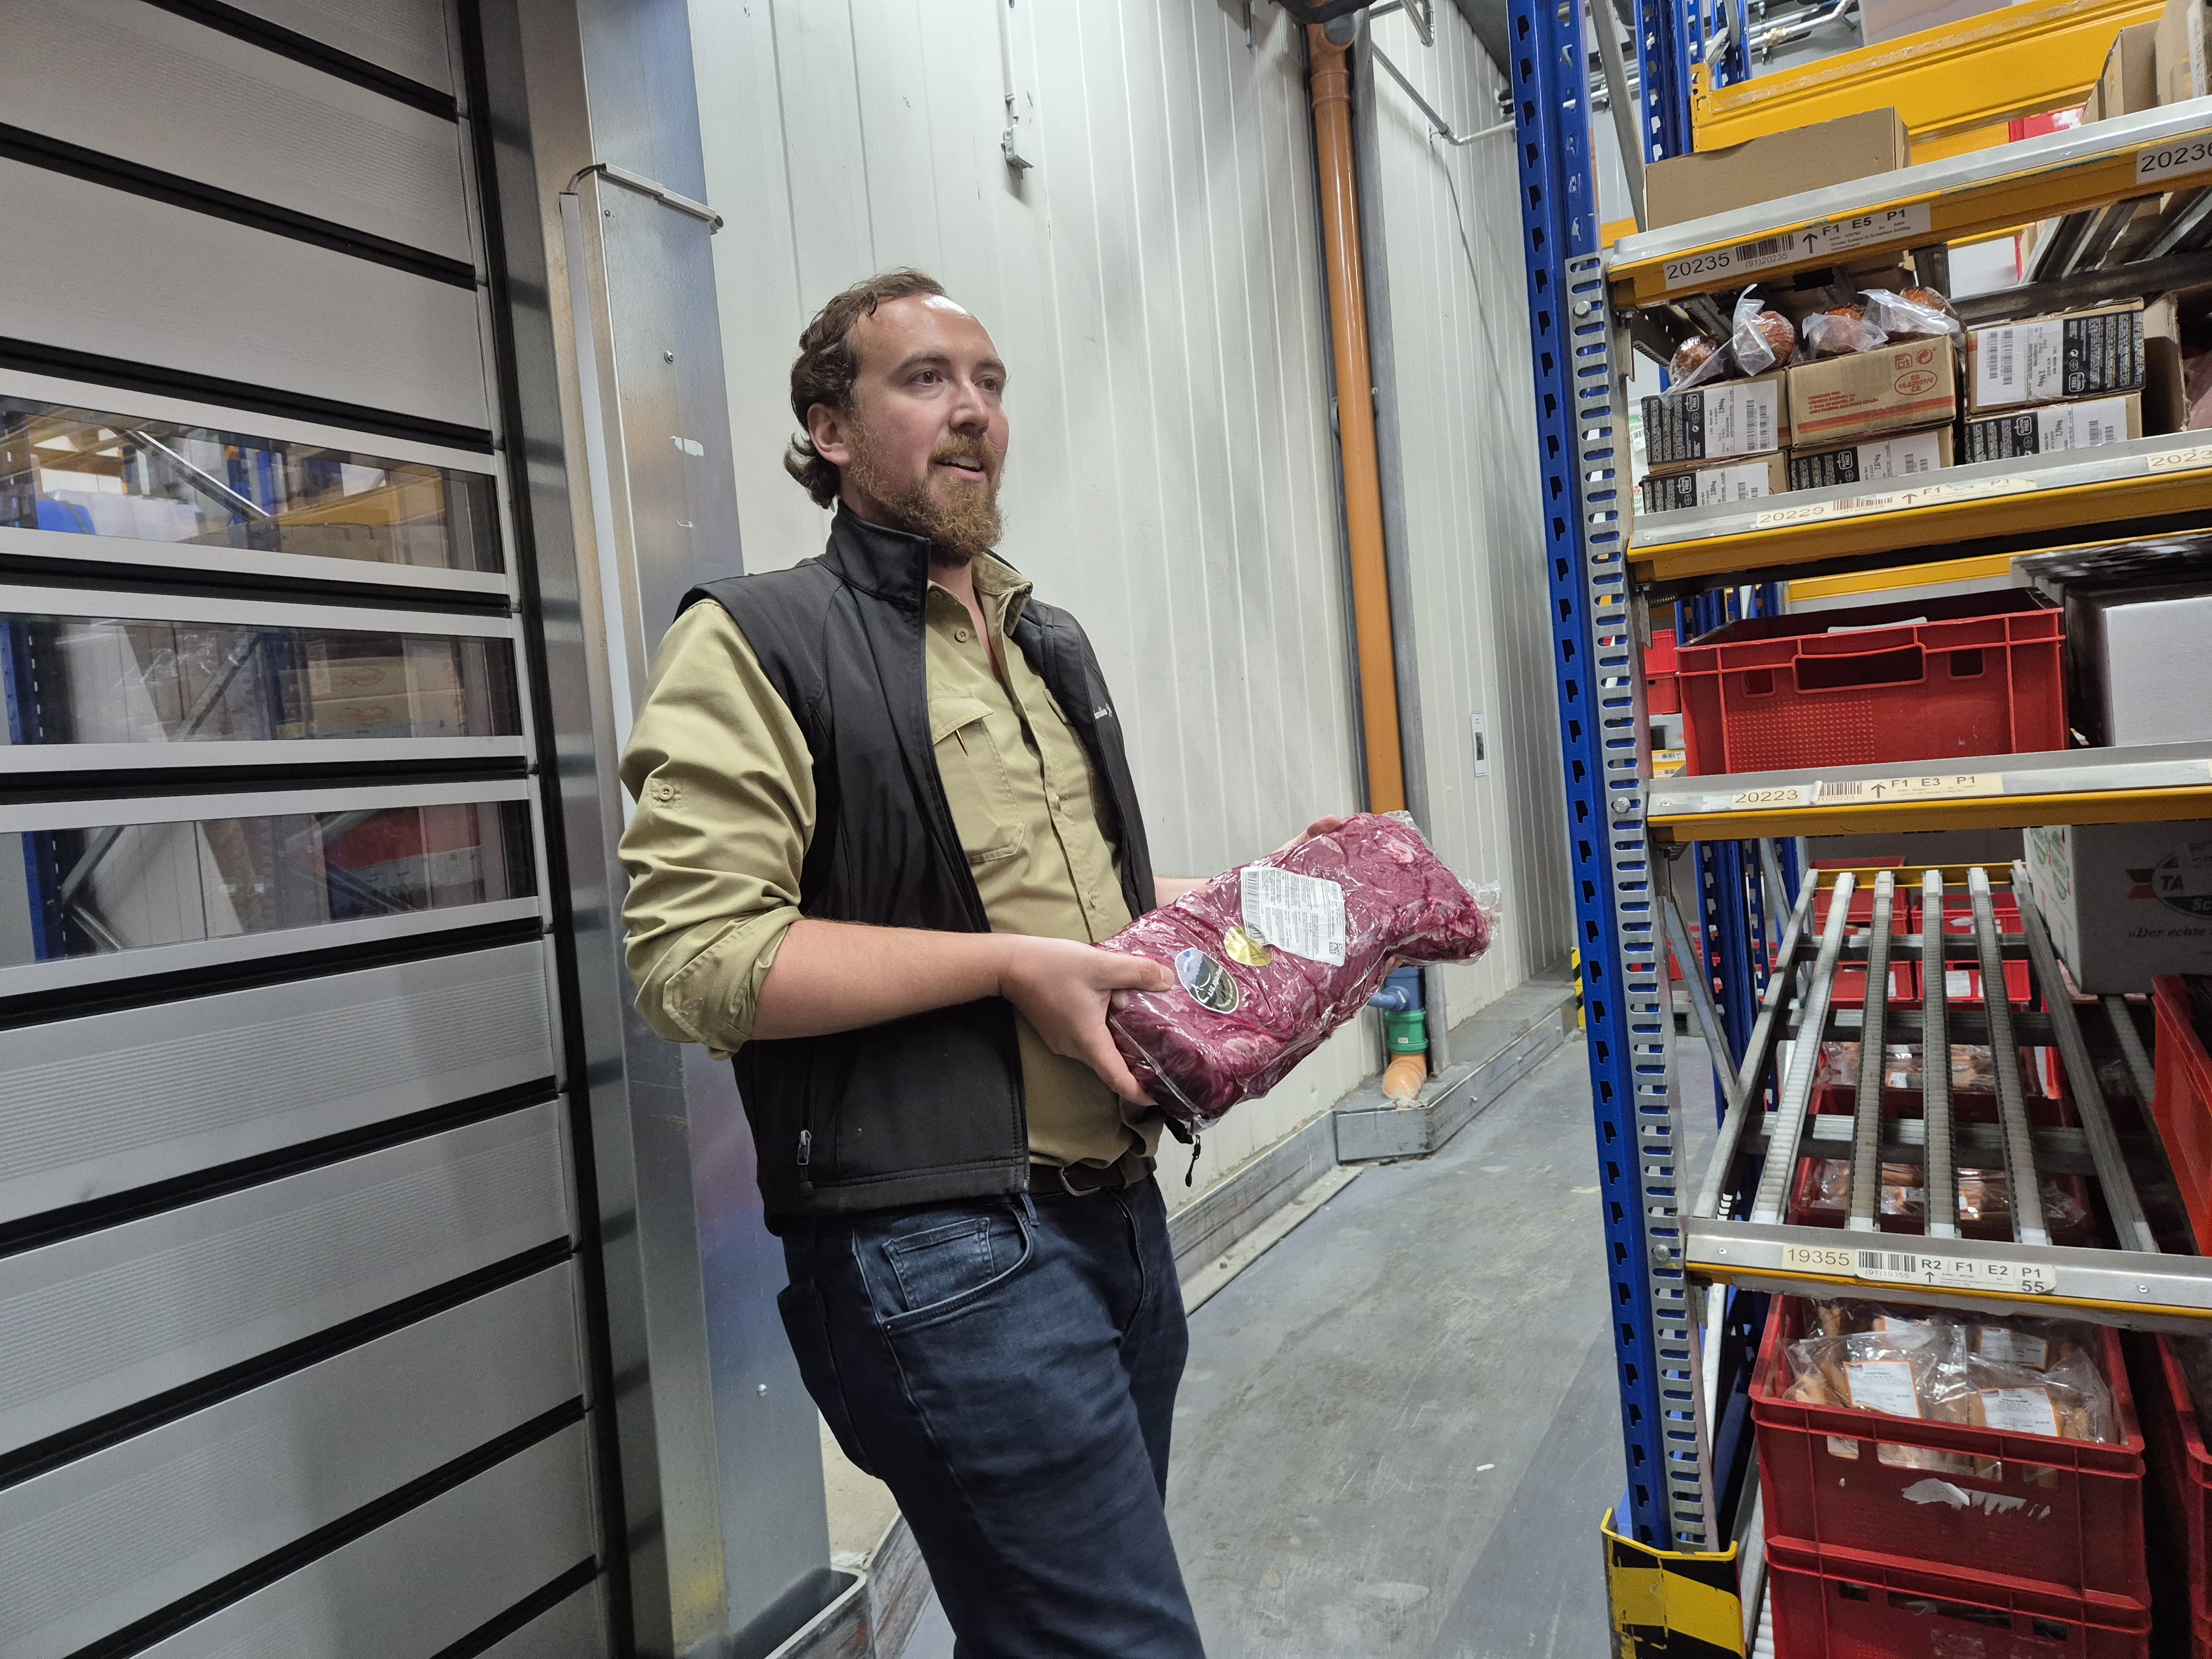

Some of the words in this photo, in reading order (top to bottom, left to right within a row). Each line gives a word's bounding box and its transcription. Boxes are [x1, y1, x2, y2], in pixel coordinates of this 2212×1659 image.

[1667, 252, 1730, 280] 20235
[1745, 252, 1788, 269] (91)20235
[1823, 224, 1839, 236] F1
[1853, 217, 1872, 229] E5
[1887, 208, 1905, 221] P1
[1760, 507, 1824, 523] 20229
[1841, 504, 1885, 514] (91)20229
[1923, 487, 1940, 495] F1
[1735, 790, 1798, 803] 20223
[1921, 778, 1940, 786] E3
[1957, 776, 1975, 784] P1
[1787, 1248, 1850, 1266] 19355
[1865, 1269, 1910, 1279] (91)19355
[1921, 1259, 1942, 1270] R2
[1955, 1261, 1973, 1272] F1
[1988, 1264, 2008, 1275] E2
[2022, 1267, 2041, 1279] P1
[2022, 1280, 2044, 1292] 55
